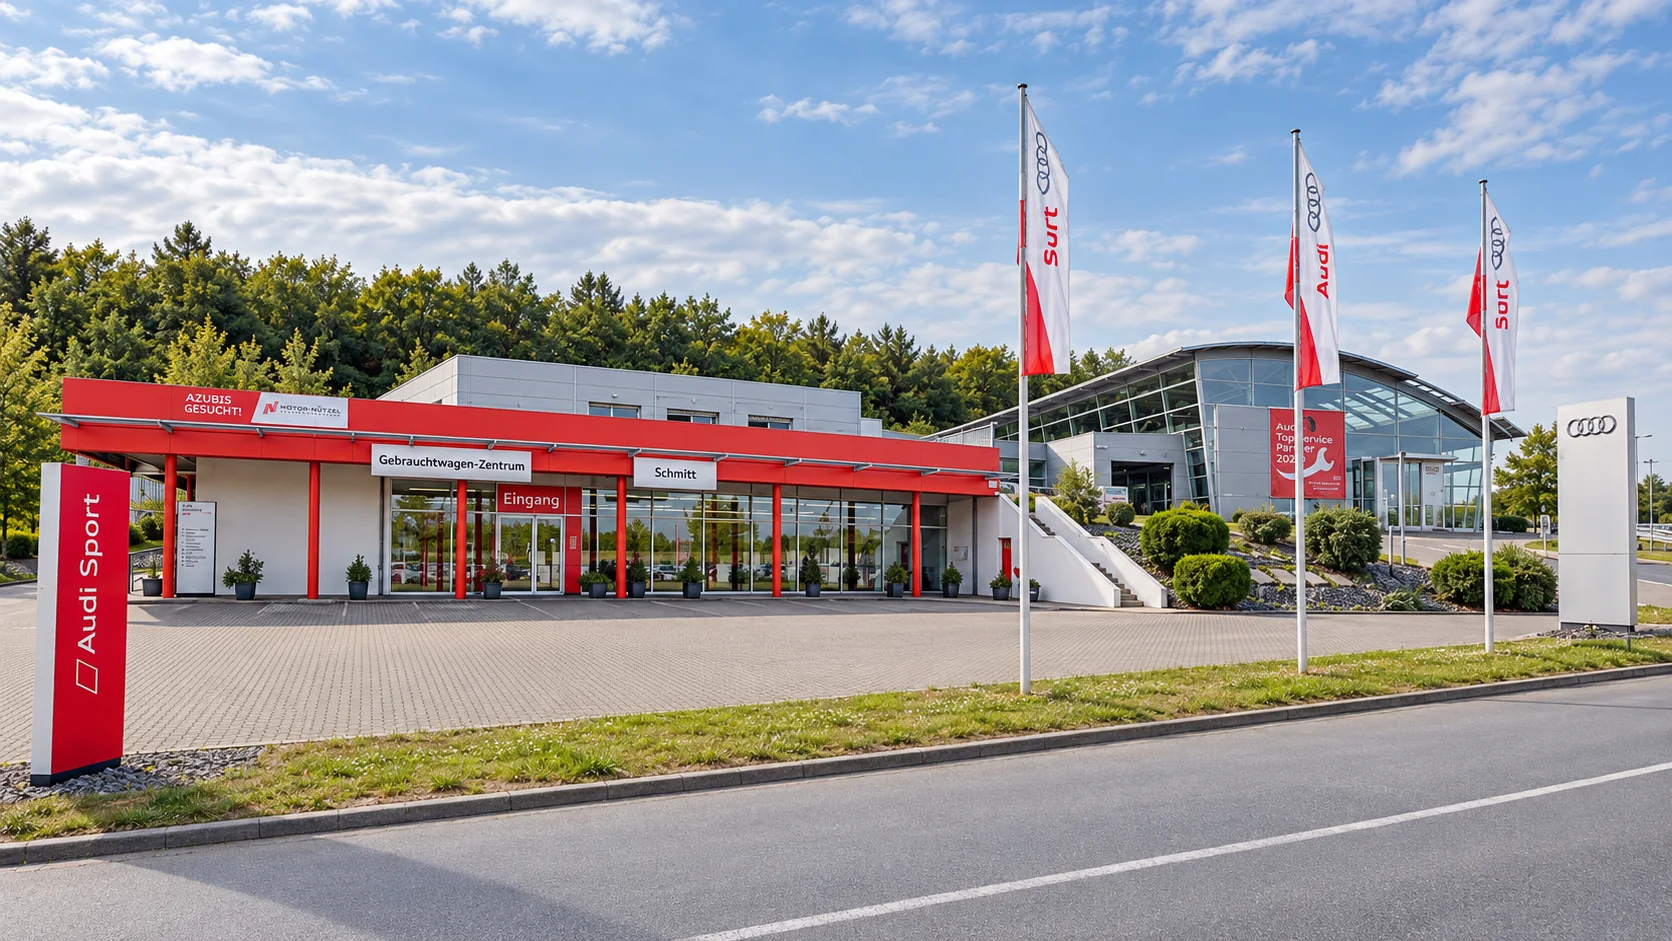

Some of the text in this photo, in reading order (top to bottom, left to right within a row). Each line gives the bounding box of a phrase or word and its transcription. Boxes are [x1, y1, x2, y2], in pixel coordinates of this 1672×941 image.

[1316, 243, 1329, 300] Audi
[185, 393, 232, 404] AZUBIS
[184, 404, 242, 416] GESUCHT!
[1303, 435, 1333, 444] ervice
[1276, 443, 1315, 453] Parer
[379, 454, 525, 471] Gebrauchtwagen-Zentrum
[1276, 454, 1306, 463] 202
[654, 466, 697, 480] Schmitt
[503, 492, 560, 509] Eingang
[77, 493, 103, 655] Audi Sport
